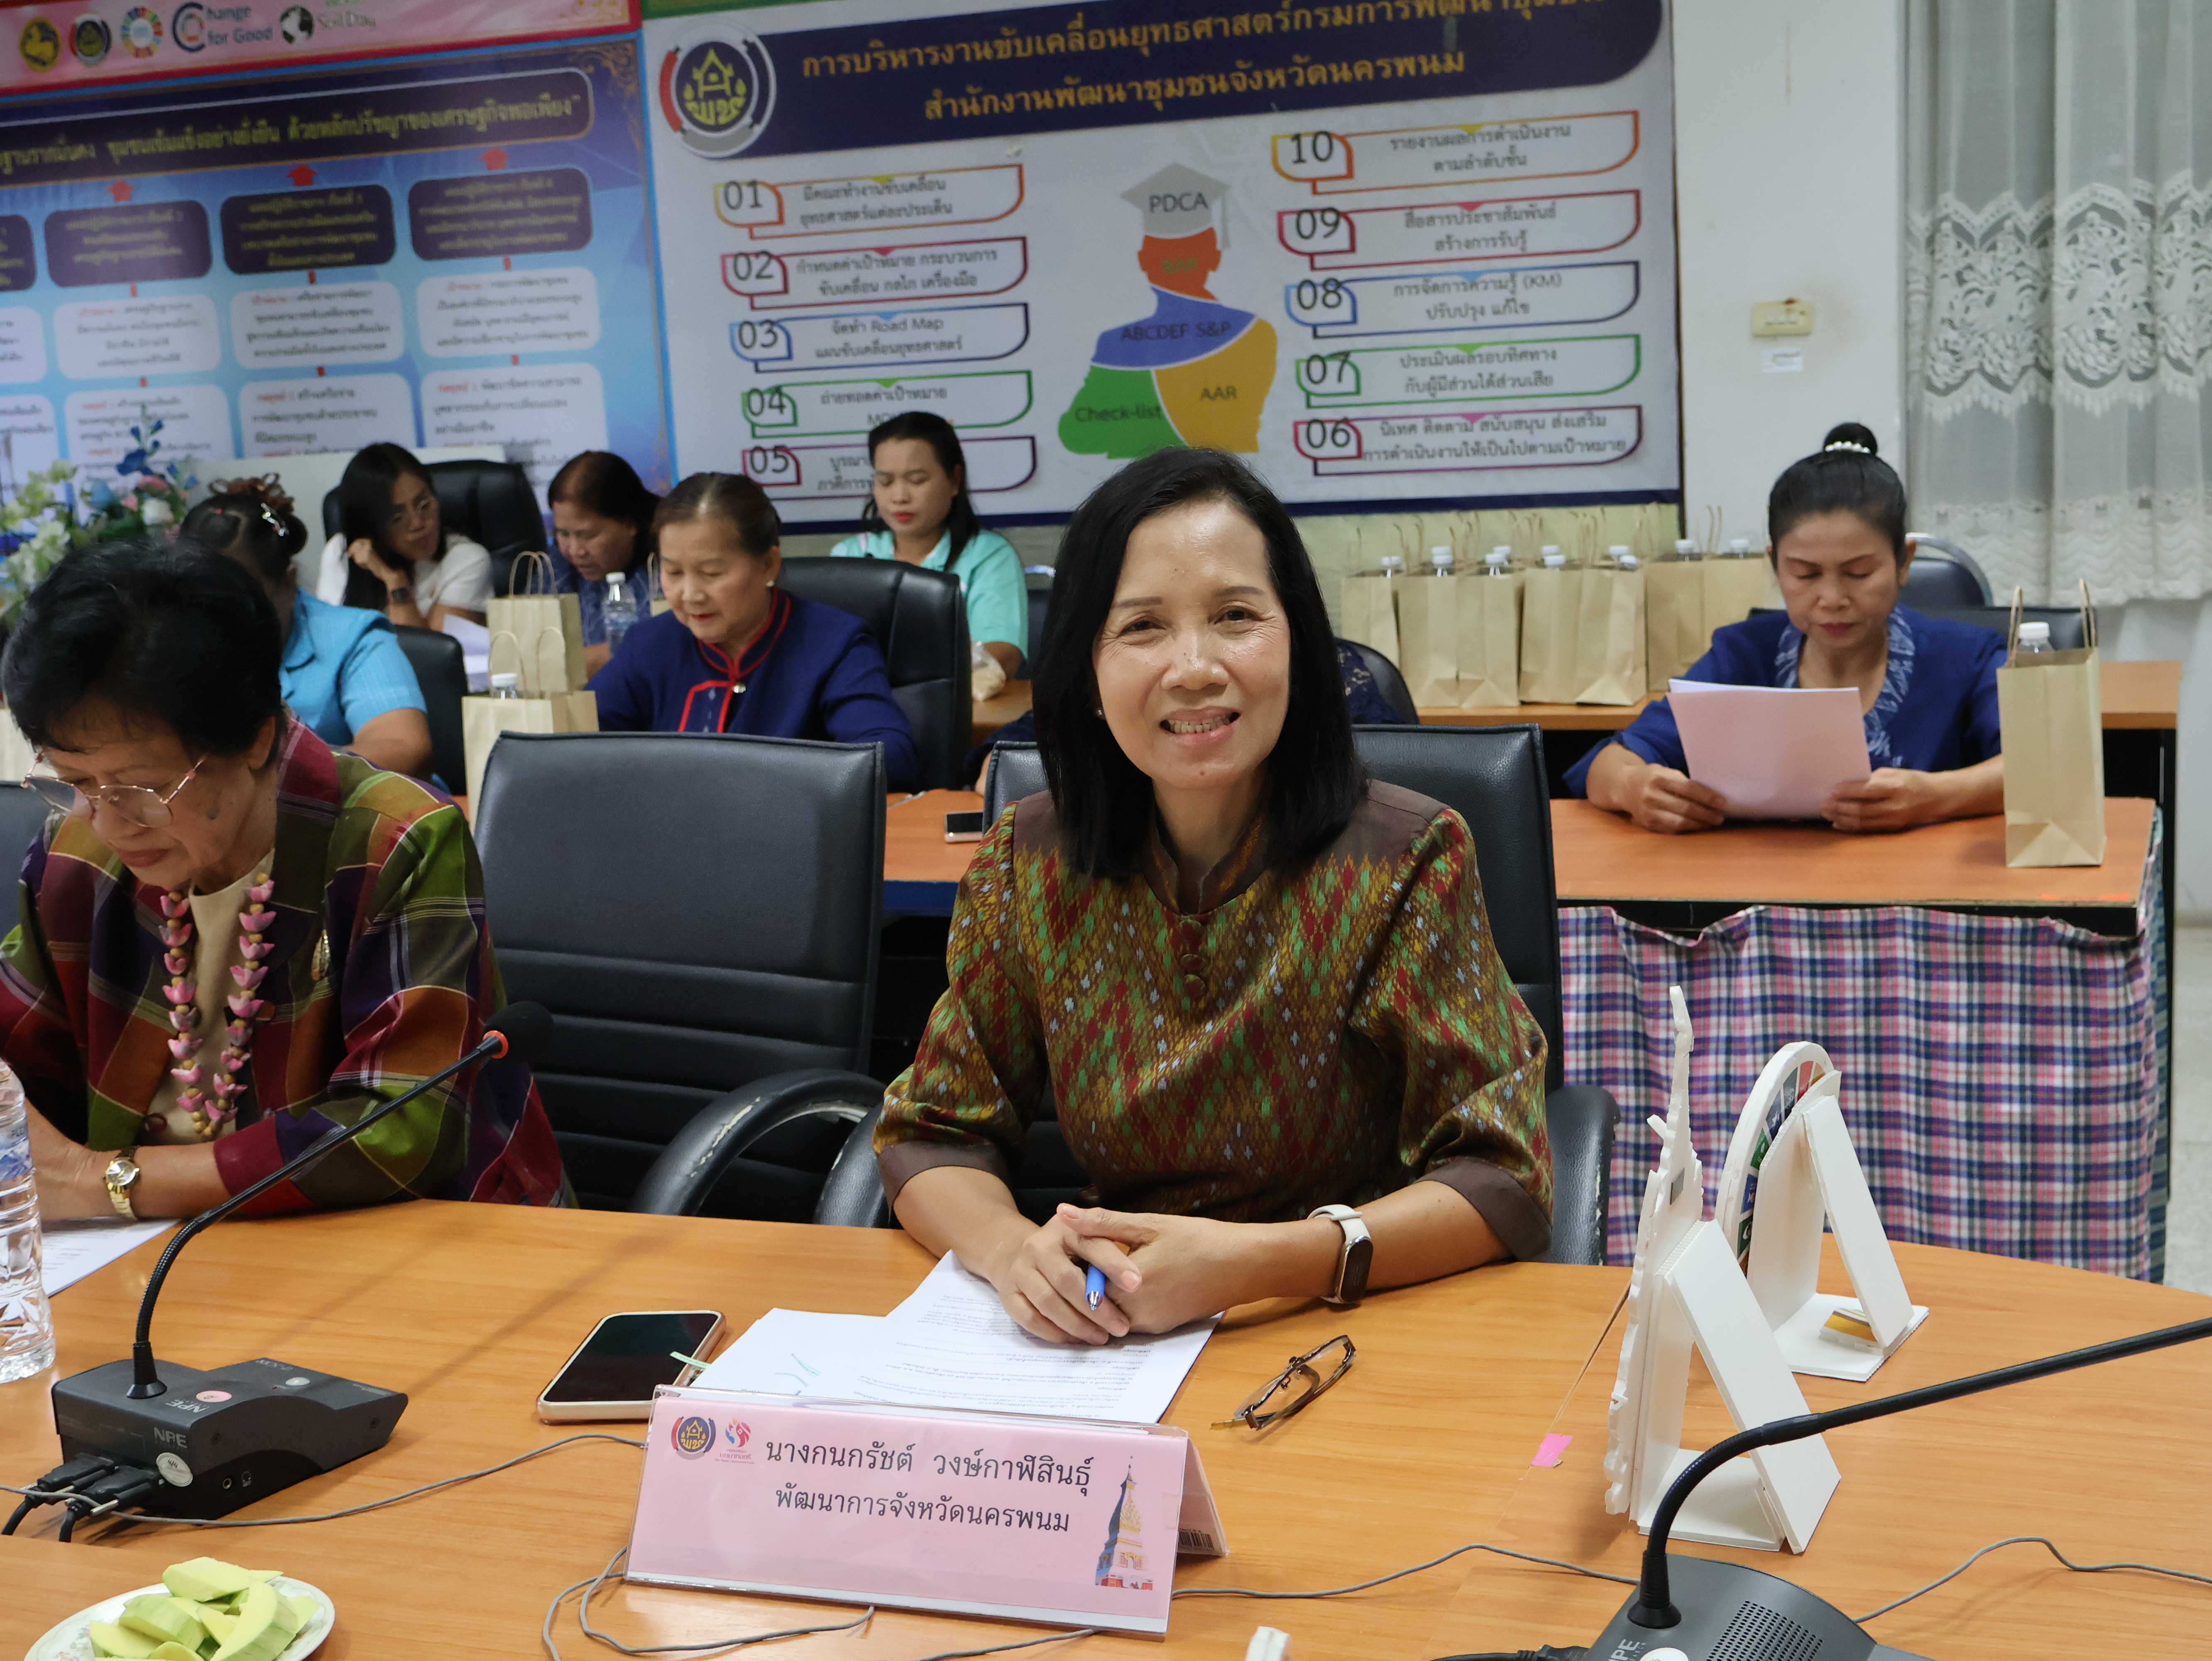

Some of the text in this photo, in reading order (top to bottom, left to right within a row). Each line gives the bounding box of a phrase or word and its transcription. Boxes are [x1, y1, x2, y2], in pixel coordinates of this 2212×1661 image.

[208, 26, 274, 45] for Good
[924, 50, 1465, 120] สำนักงานพัฒนาชุมชนจังหวัดนครพนม
[1290, 131, 1334, 164] 10
[724, 180, 763, 210] 01
[1149, 192, 1209, 213] PDCA
[1296, 207, 1341, 240] 09
[732, 250, 775, 281] 02
[1296, 277, 1343, 310] 08
[1522, 271, 1563, 291] (KM)
[1425, 298, 1531, 322] ปรับปรุง แก้ไข
[737, 319, 779, 350] 03
[871, 318, 908, 333] Road
[912, 317, 945, 334] Map
[1121, 323, 1189, 342] ABCDEF
[1306, 351, 1351, 385] 07
[747, 385, 787, 416] 04
[1199, 385, 1238, 402] AAR
[1305, 416, 1352, 449] 06
[749, 446, 790, 475] 05
[165, 1399, 210, 1413] NPE
[154, 1427, 187, 1448] NPE
[766, 1440, 1095, 1497] นางกนกรัชต์ วงษ์กาฬสินธุ์
[775, 1483, 1070, 1532] พัฒนาการจังหวัดนครพนม
[1608, 1639, 1640, 1661] PE
